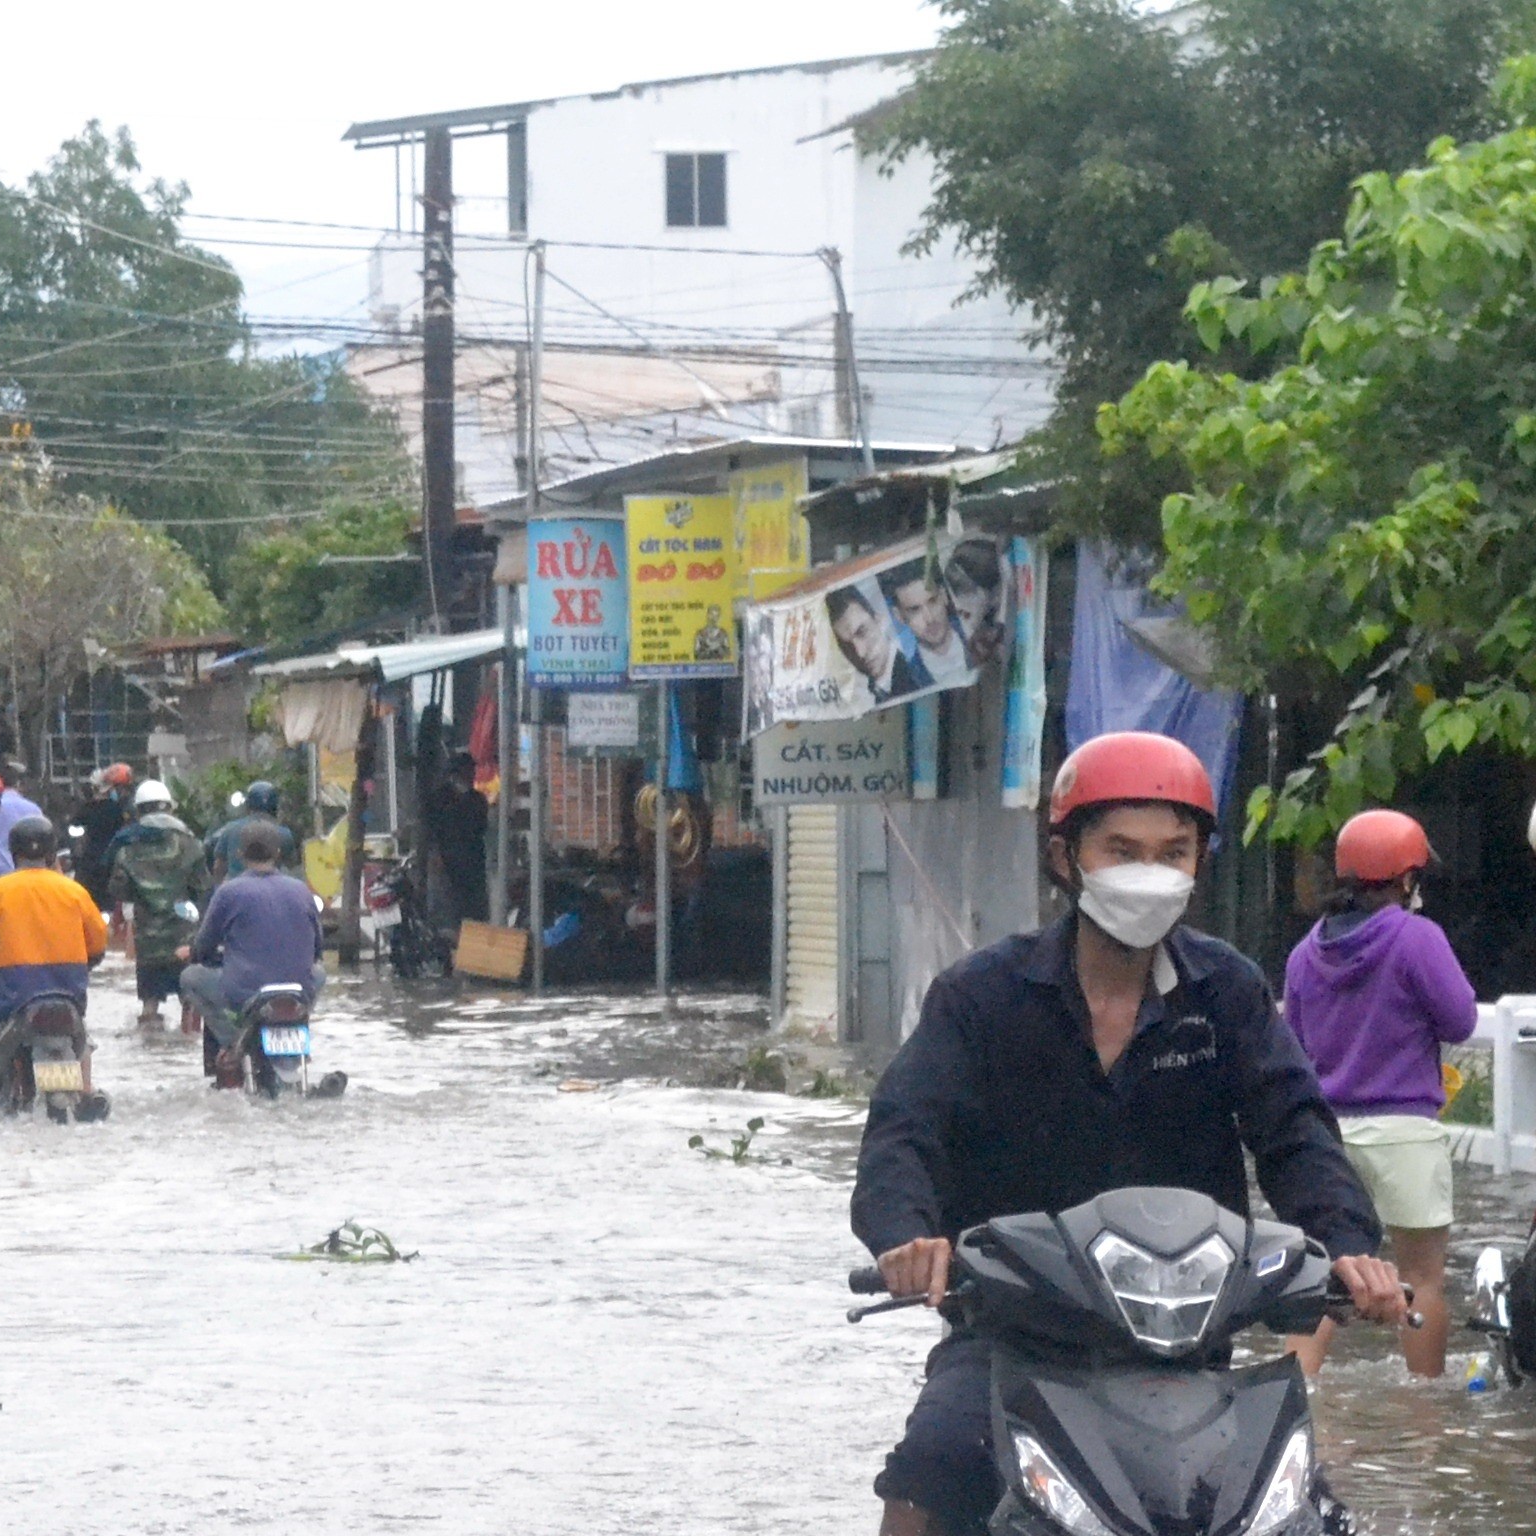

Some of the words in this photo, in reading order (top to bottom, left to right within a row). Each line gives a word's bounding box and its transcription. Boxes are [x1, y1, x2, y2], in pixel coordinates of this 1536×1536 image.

[536, 525, 621, 581] RỬA
[551, 588, 606, 628] XE
[570, 630, 620, 653] TUYẾT
[836, 738, 885, 761] SẤY
